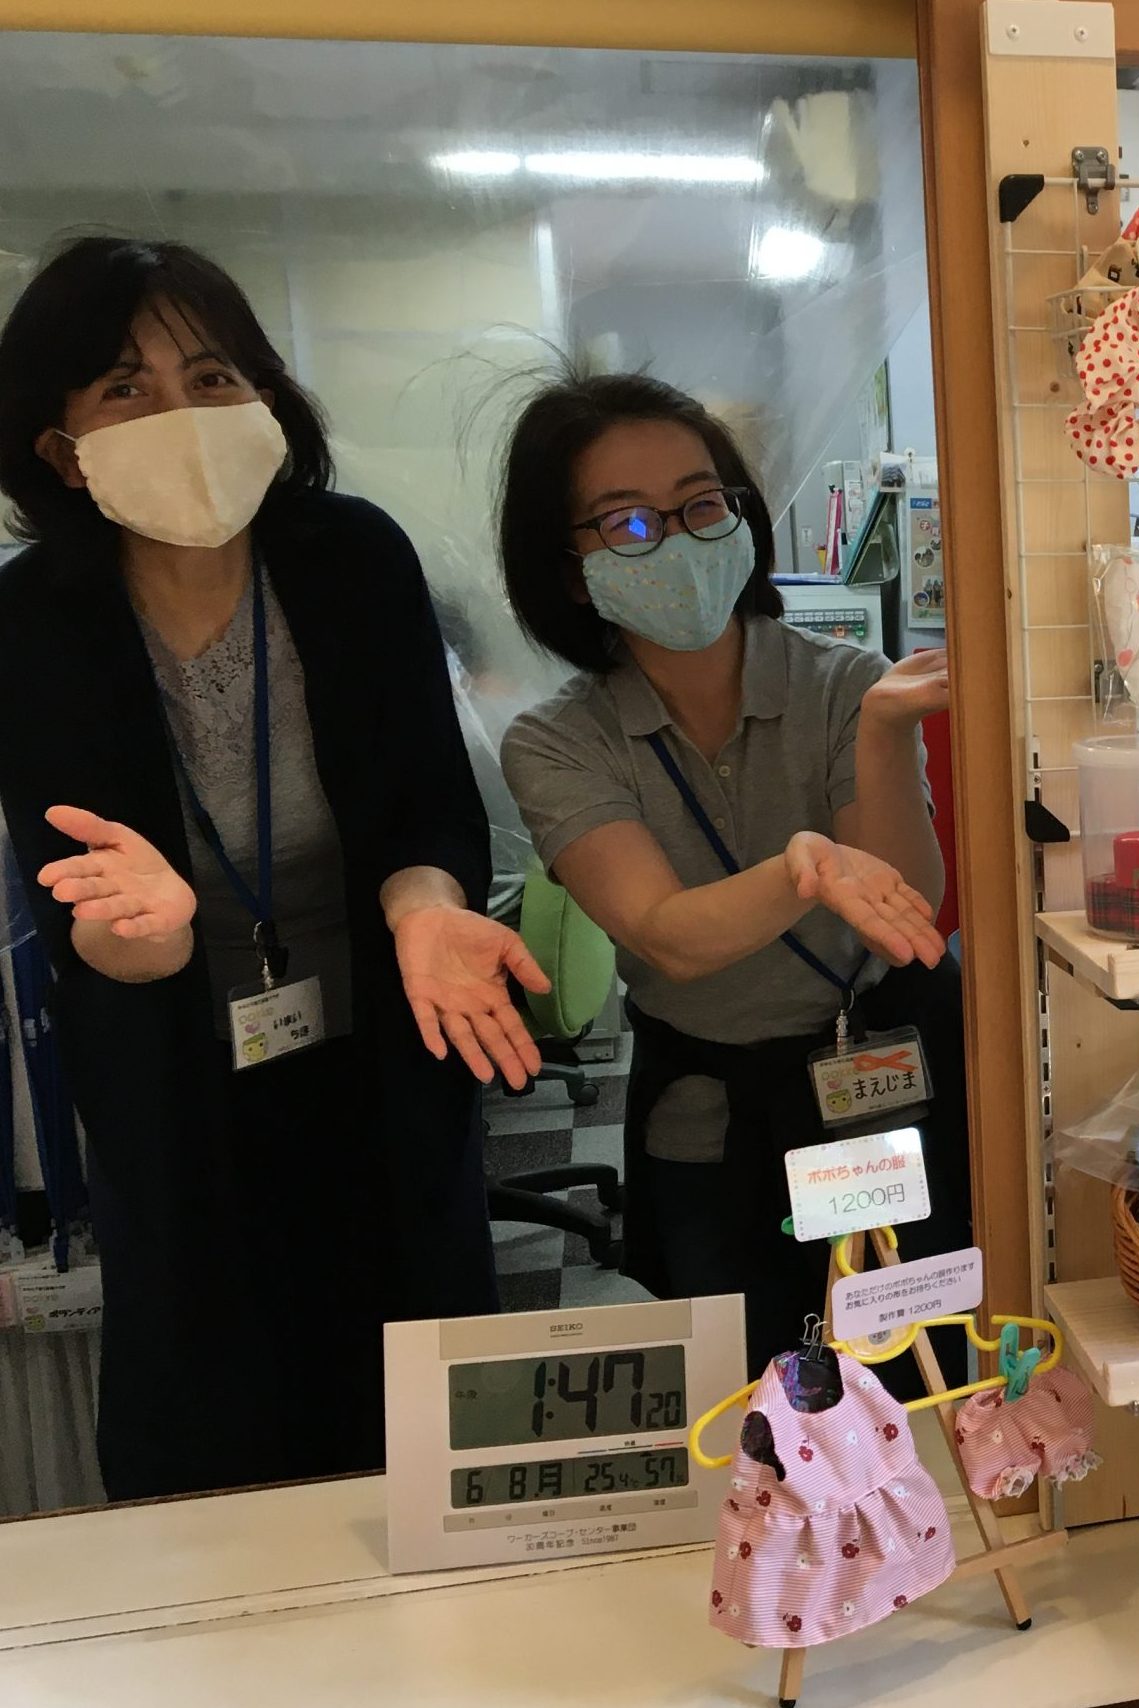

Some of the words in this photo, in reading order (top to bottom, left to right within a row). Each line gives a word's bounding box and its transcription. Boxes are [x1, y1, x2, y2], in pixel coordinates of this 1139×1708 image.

[853, 1072, 917, 1099] まえじま
[829, 1183, 905, 1215] 1200円
[879, 1308, 905, 1323] 製作費
[909, 1299, 942, 1314] 1200円
[550, 1322, 583, 1332] SEIKO
[531, 1352, 645, 1437] 1:47
[646, 1390, 681, 1428] 20
